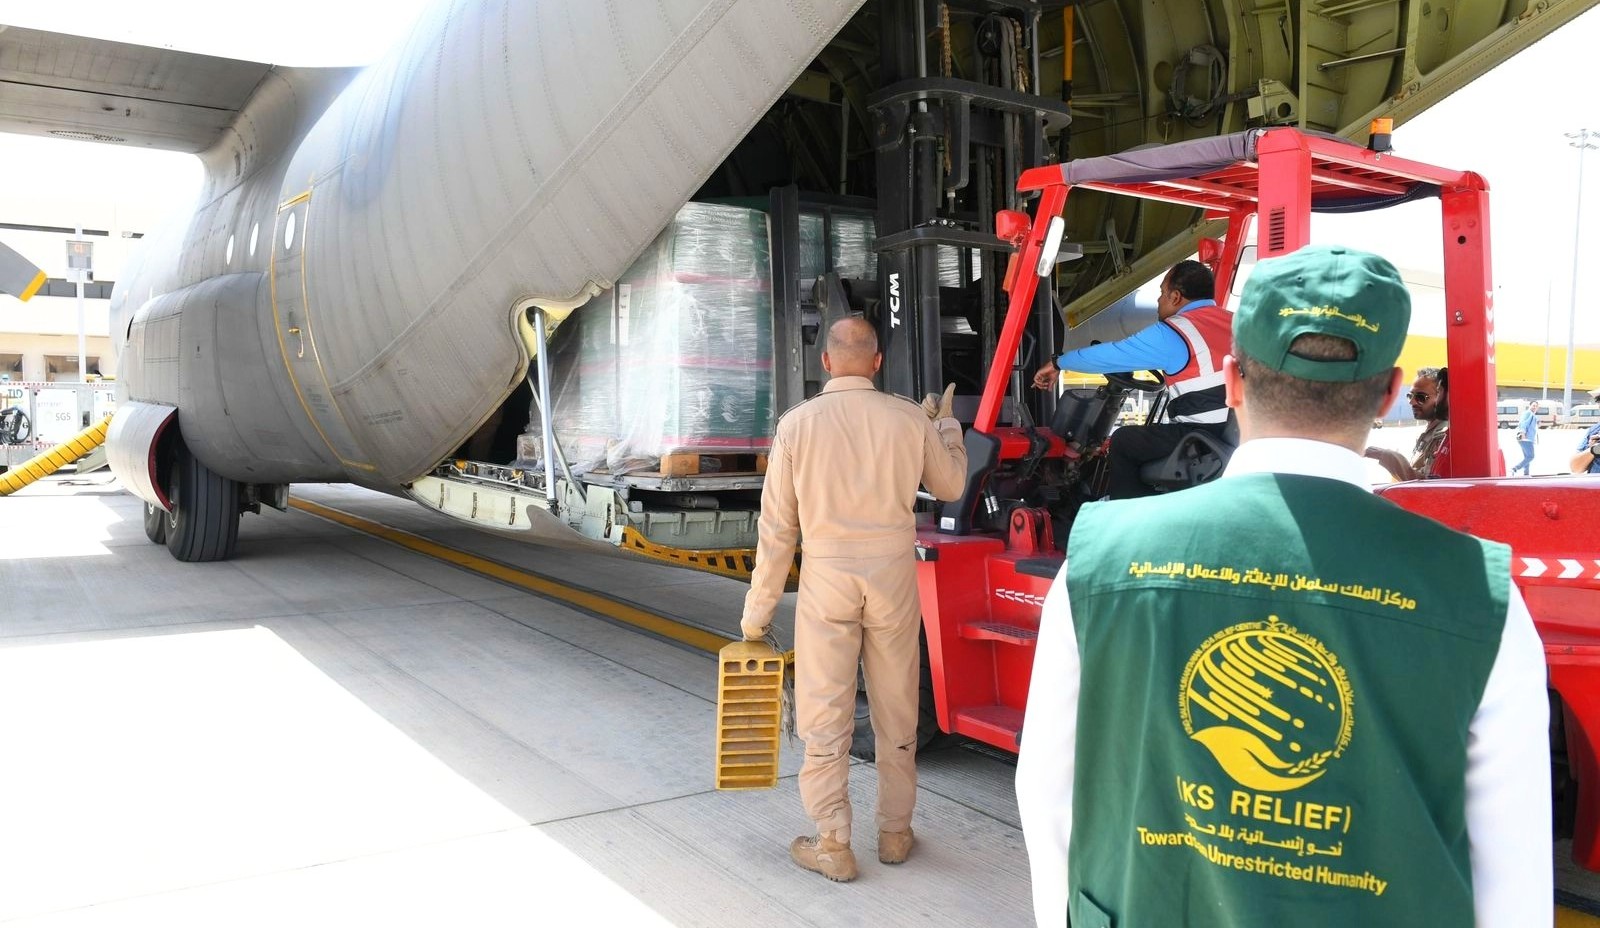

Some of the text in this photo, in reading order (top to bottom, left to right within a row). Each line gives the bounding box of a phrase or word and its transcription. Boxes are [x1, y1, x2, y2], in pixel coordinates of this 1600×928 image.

[889, 272, 901, 329] TCM
[1289, 574, 1339, 593] سلمان
[1340, 584, 1382, 602] الملك
[1380, 589, 1417, 610] مركز
[1217, 824, 1235, 841] بلا
[1306, 841, 1343, 857] نحو
[1207, 843, 1314, 883] Unrestricted
[1315, 864, 1388, 896] Humanity
